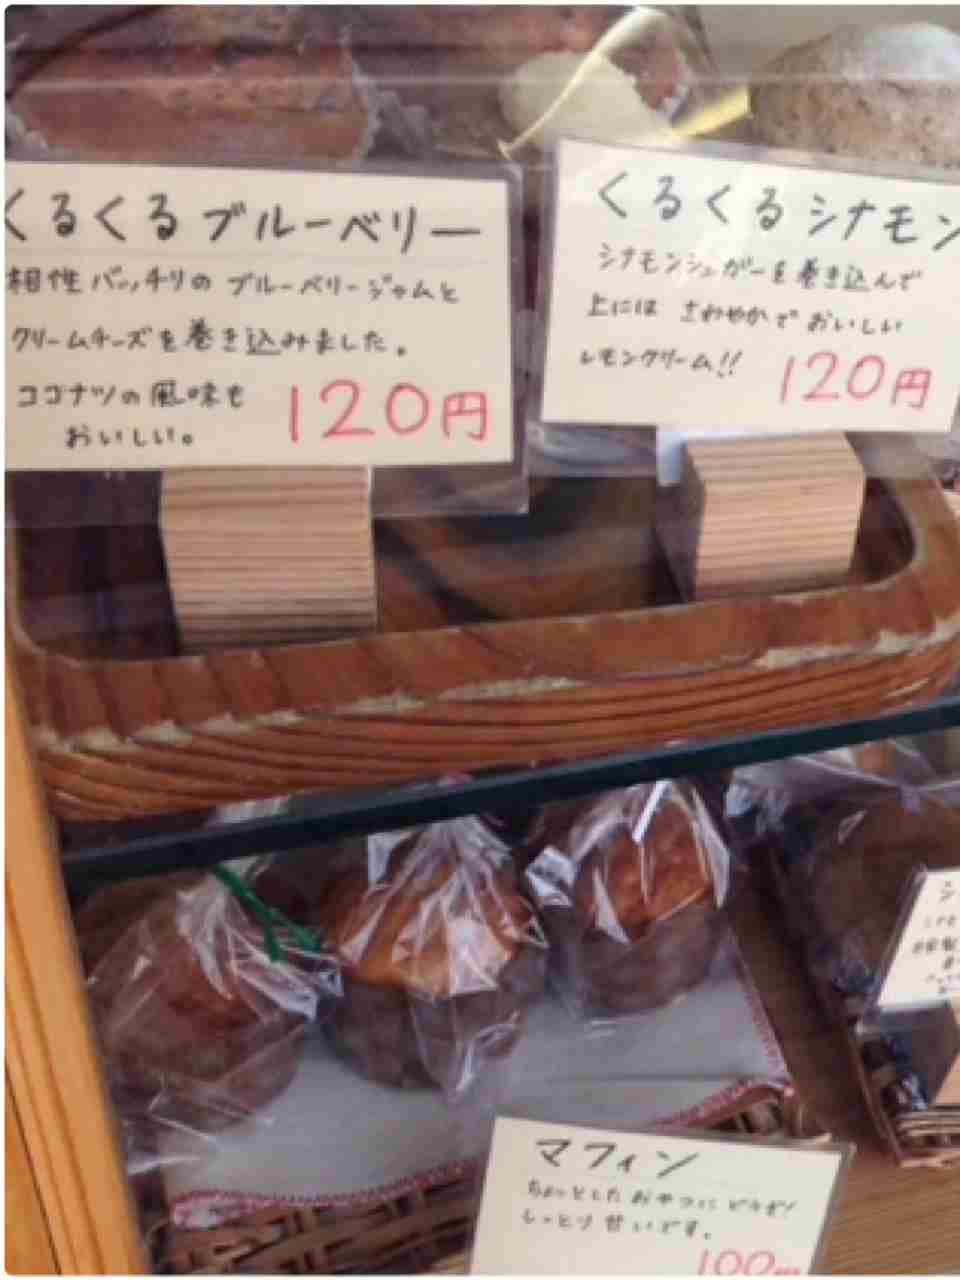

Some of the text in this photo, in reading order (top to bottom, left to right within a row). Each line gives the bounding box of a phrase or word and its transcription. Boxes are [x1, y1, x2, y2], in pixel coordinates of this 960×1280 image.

[778, 350, 934, 411] 120円
[287, 377, 490, 444] 120円
[534, 1137, 700, 1179] マフィン
[698, 1248, 801, 1276] 100
